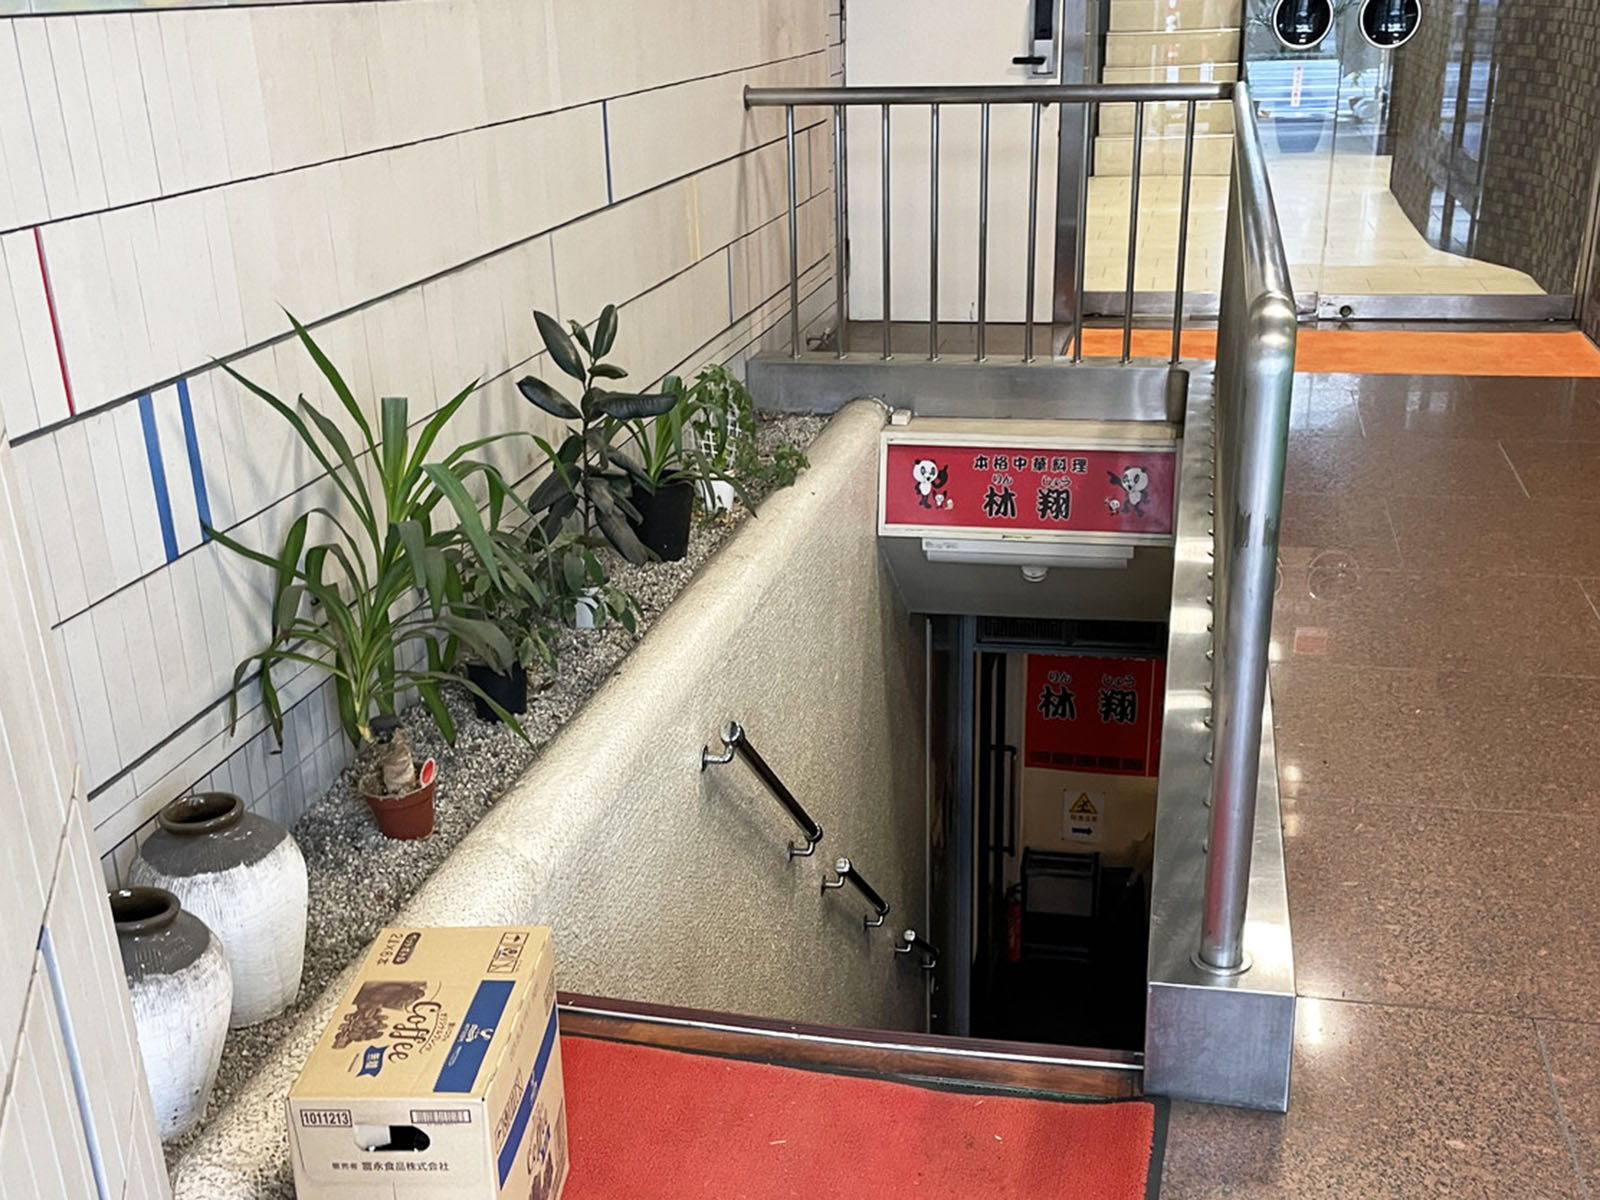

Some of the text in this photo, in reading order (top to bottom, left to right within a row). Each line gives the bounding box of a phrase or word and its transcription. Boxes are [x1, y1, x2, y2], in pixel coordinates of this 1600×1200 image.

[973, 455, 1088, 473] 本格中華料理
[982, 485, 1071, 519] 林翔
[1037, 684, 1138, 725] 林翔
[388, 1001, 442, 1063] Coffee
[303, 1111, 349, 1125] 1011213
